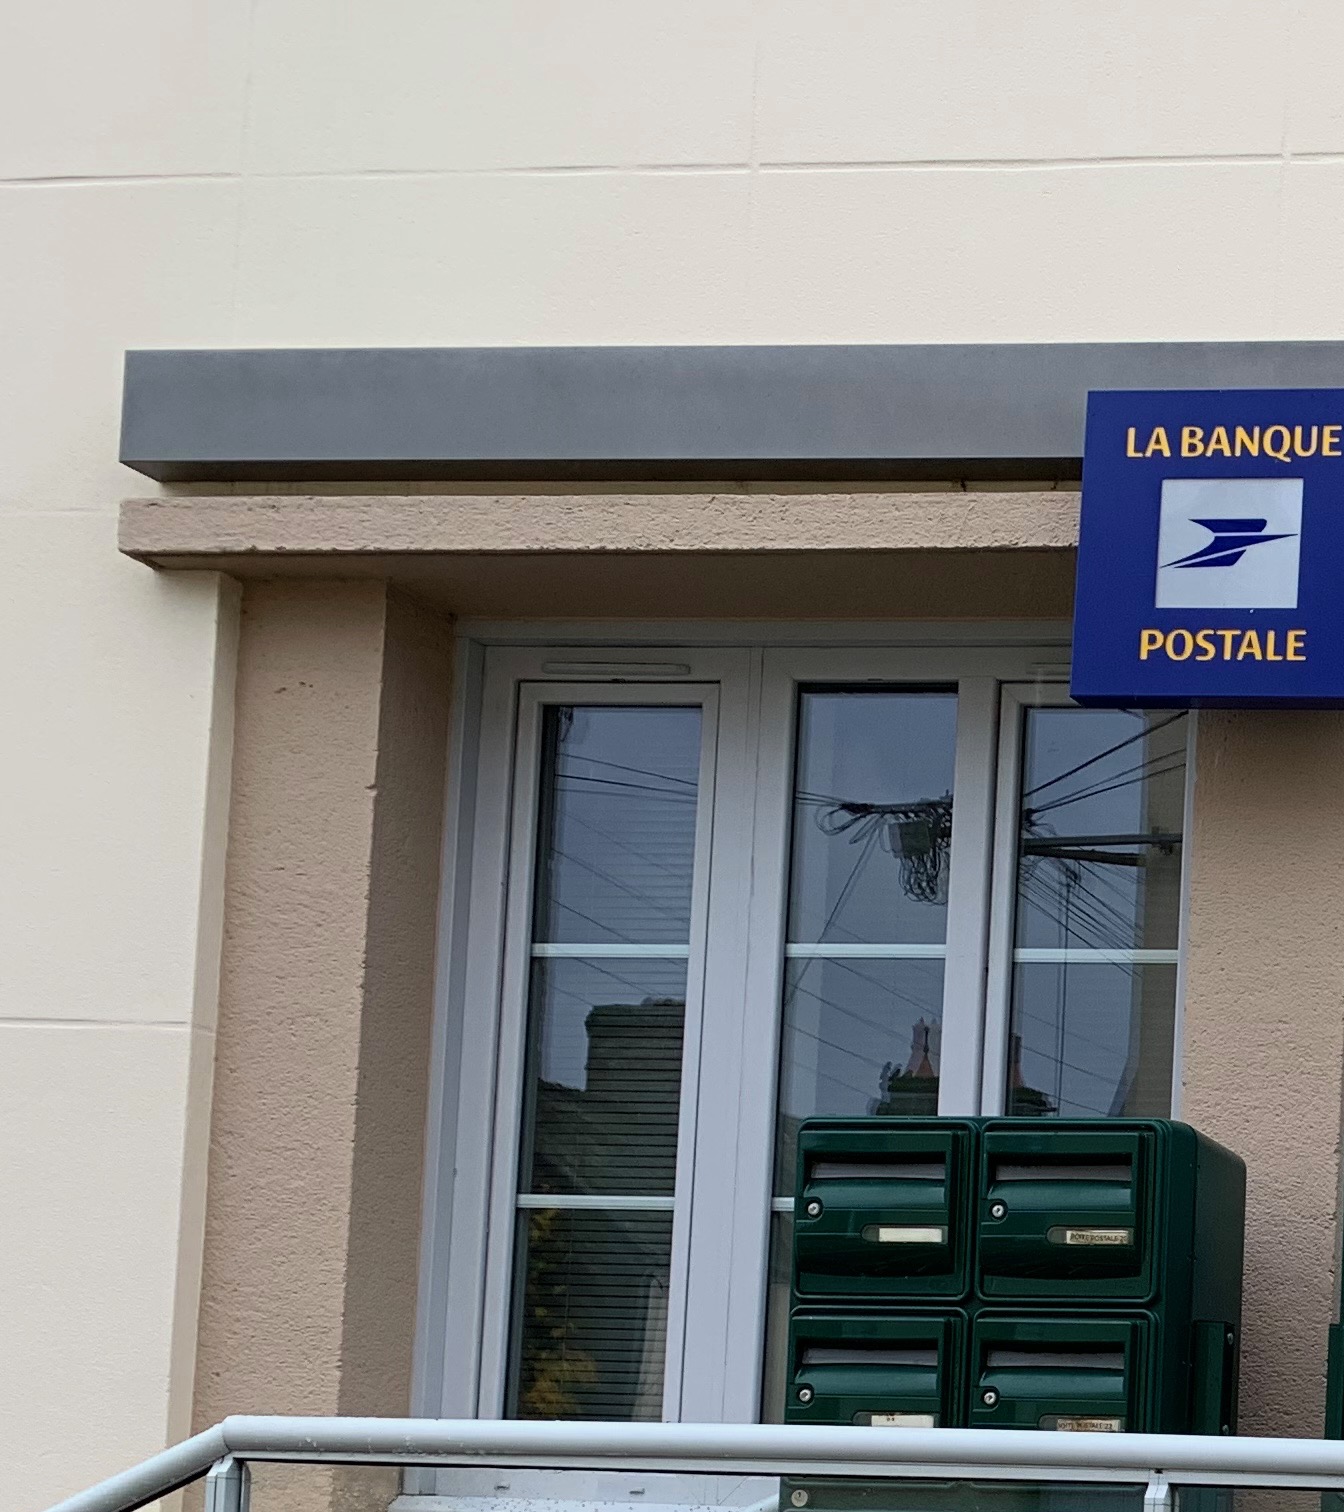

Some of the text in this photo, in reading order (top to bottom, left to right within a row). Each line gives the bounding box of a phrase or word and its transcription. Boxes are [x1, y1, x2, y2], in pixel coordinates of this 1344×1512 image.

[1126, 424, 1343, 463] LA BANQUE
[1138, 628, 1307, 661] POSTALE
